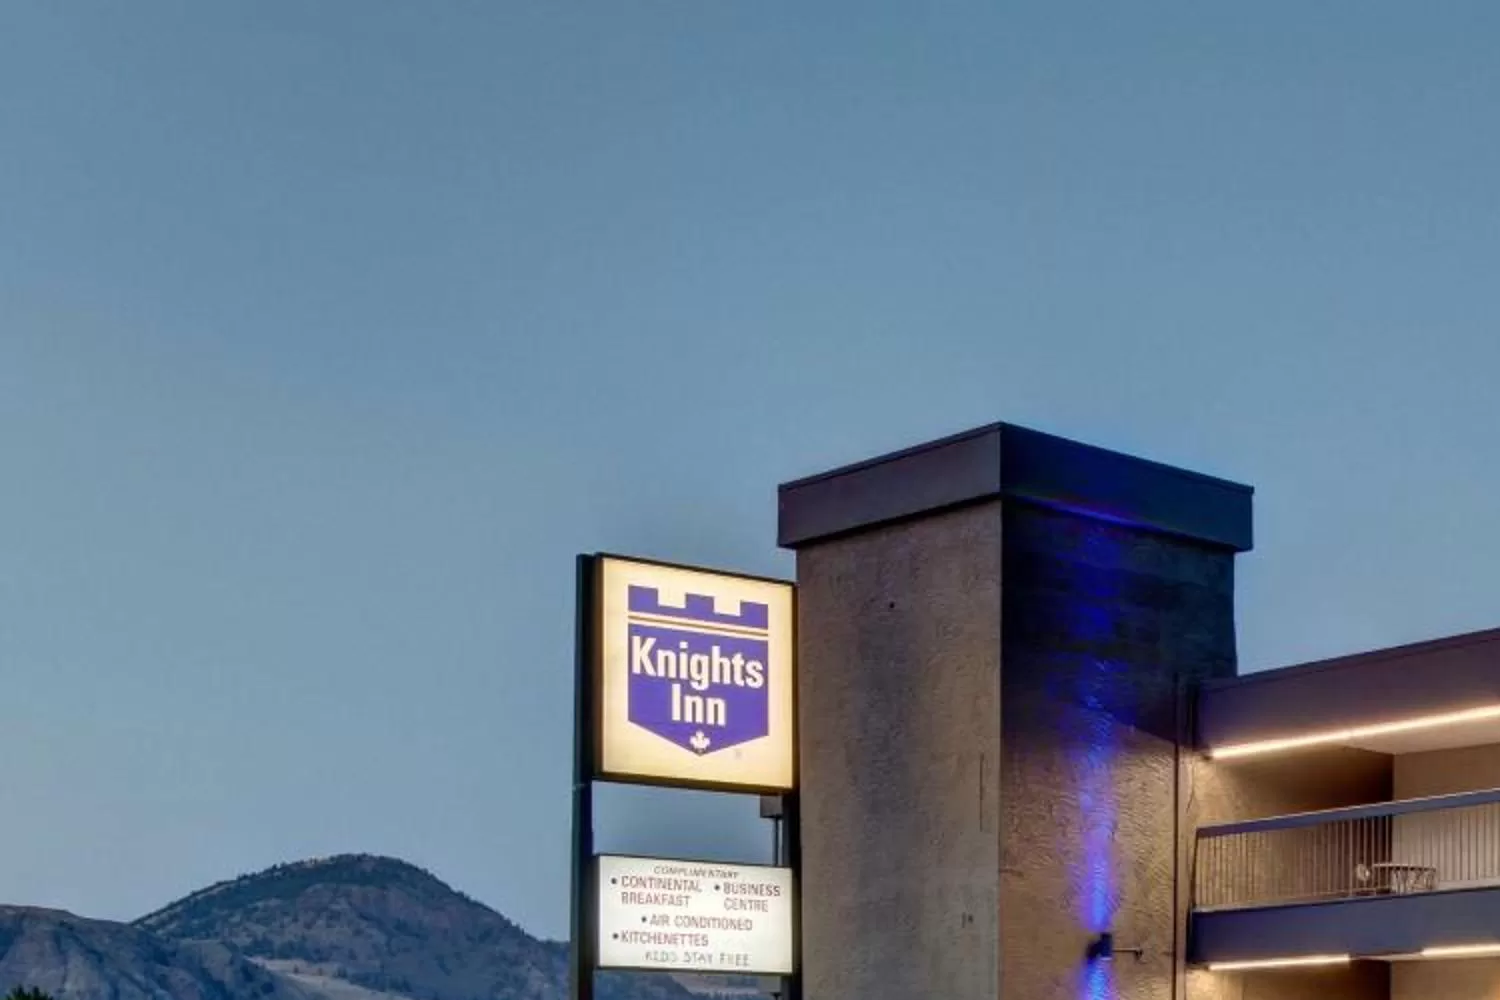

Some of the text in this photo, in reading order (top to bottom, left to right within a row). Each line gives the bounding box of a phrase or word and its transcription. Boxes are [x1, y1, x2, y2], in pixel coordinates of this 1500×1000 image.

[632, 635, 764, 690] Knights
[672, 683, 726, 726] Inn
[621, 876, 702, 892] CONTINENTAL
[723, 882, 781, 897] BUSINESS
[621, 892, 691, 908] BREAKFAST
[723, 899, 769, 913] CENTRE
[649, 914, 753, 931] AIR CONDITIONED
[621, 930, 709, 947] KITCHENETTES
